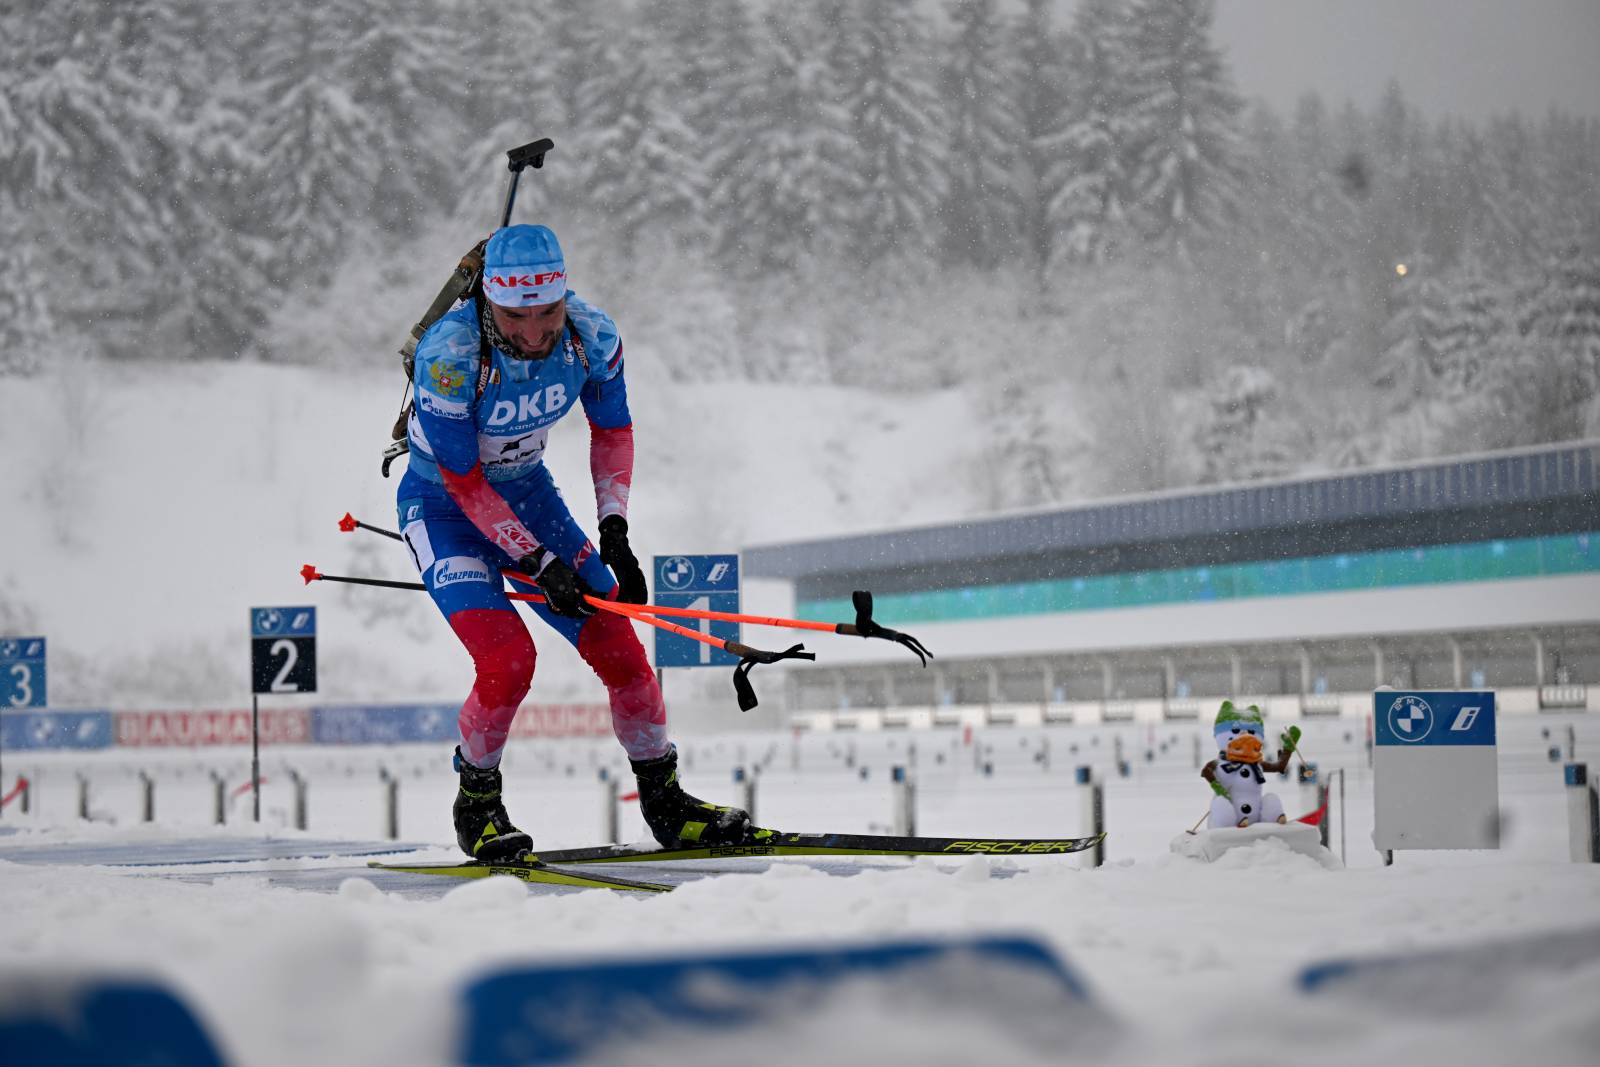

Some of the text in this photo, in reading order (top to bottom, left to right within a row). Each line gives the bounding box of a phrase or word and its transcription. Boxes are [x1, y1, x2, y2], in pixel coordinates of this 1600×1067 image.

[486, 383, 567, 425] DKB
[685, 596, 711, 664] 1
[9, 663, 33, 708] 3
[270, 639, 299, 693] 2
[118, 709, 306, 745] BAUHAUS
[709, 846, 777, 857] FISCHER
[943, 840, 1075, 853] FISCHER
